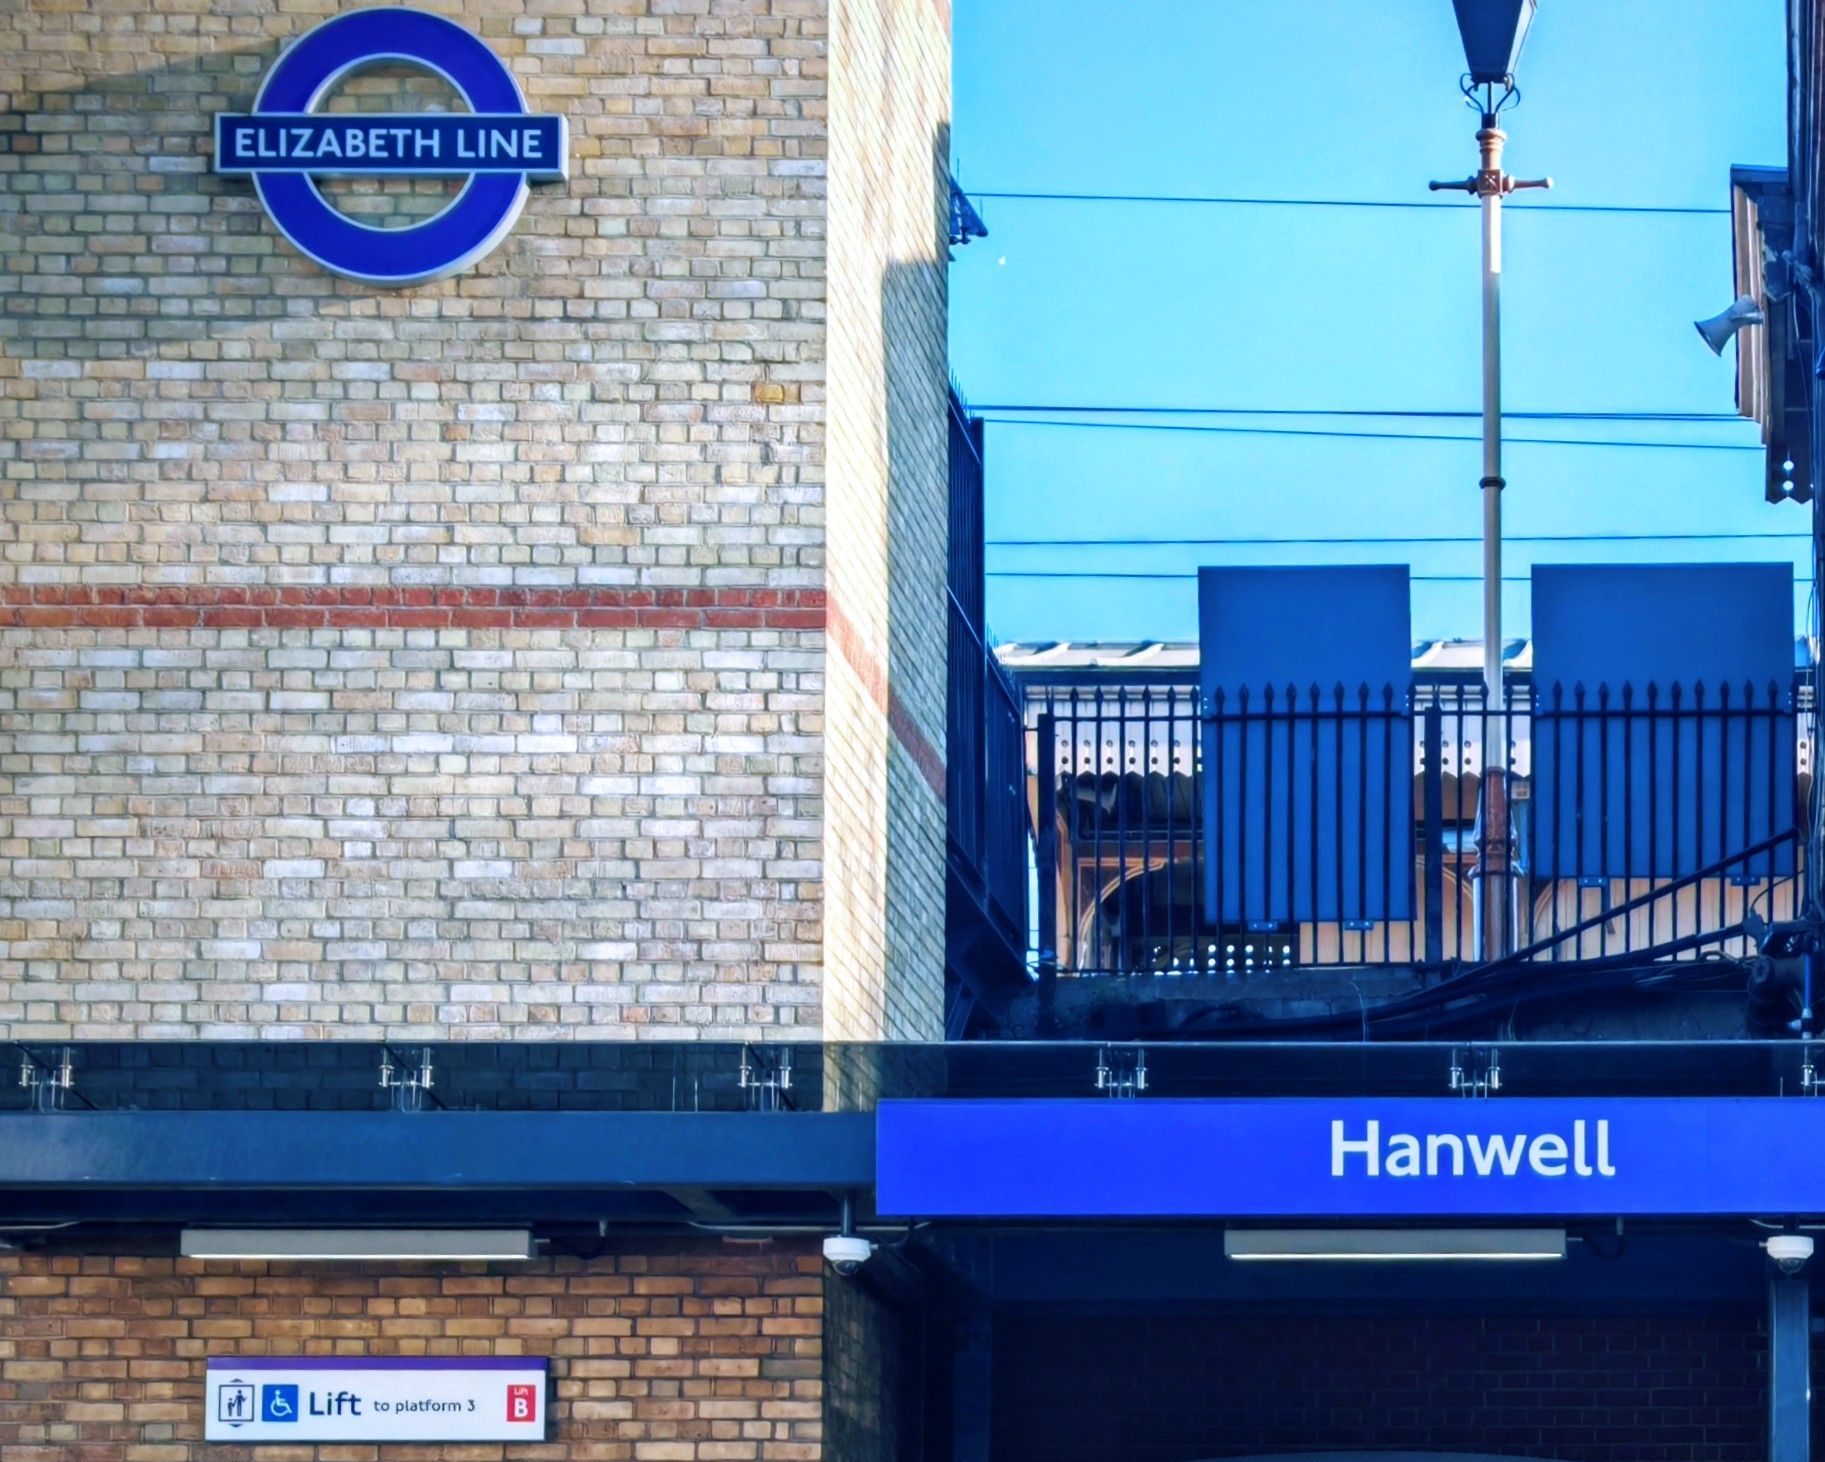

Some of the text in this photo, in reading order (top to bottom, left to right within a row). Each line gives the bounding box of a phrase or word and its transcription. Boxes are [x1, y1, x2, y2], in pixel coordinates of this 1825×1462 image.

[235, 129, 542, 158] ELIZABETH LINE
[1331, 1119, 1616, 1176] Hanwell
[309, 1391, 475, 1416] Lift to platform 3
[514, 1398, 528, 1417] B
